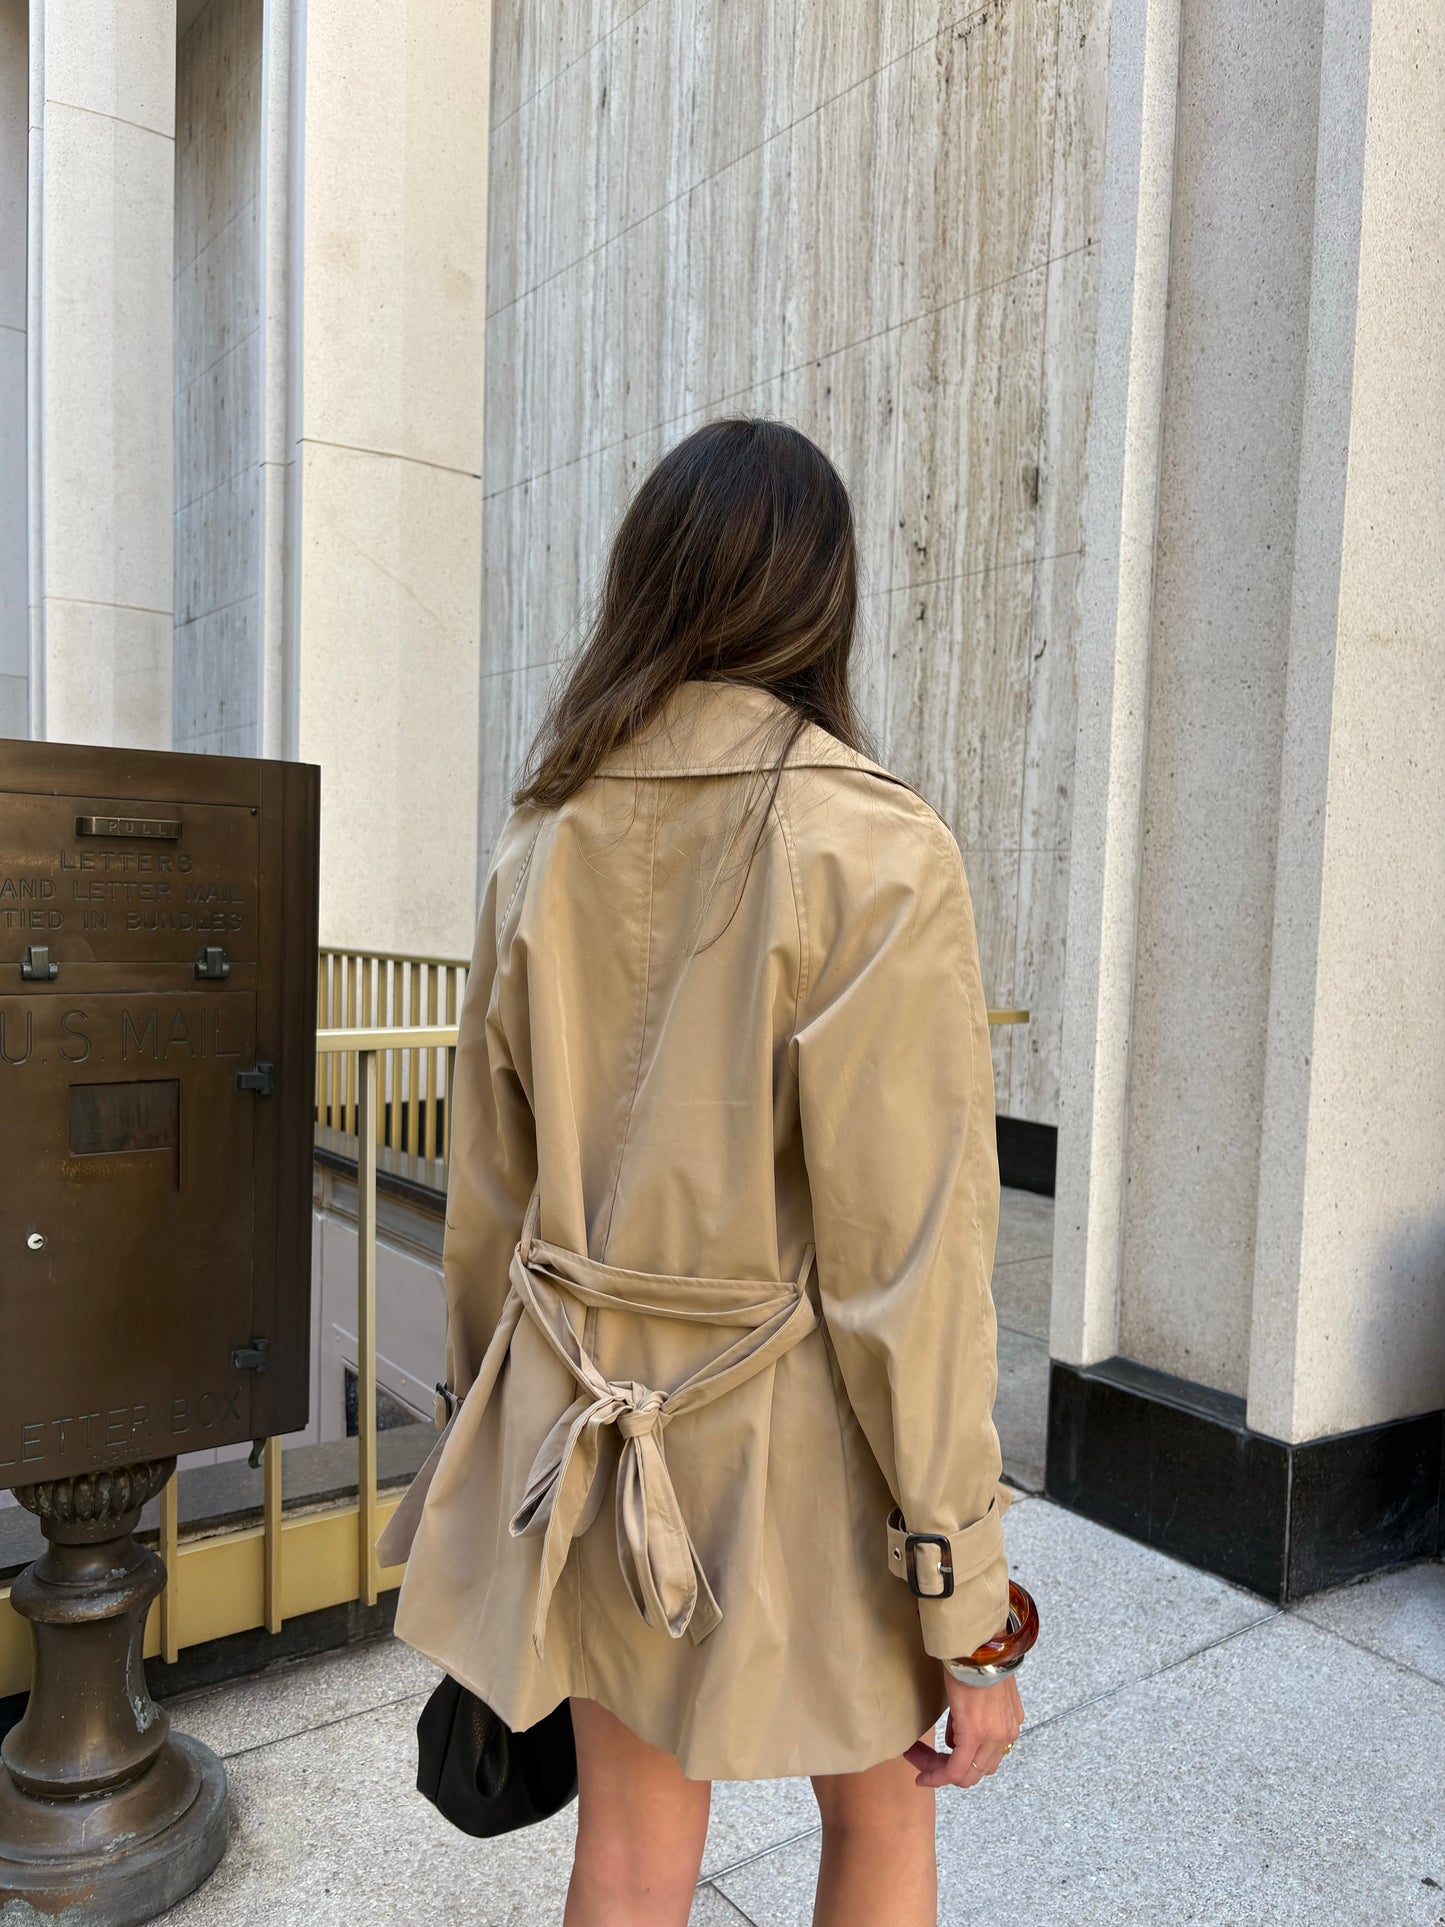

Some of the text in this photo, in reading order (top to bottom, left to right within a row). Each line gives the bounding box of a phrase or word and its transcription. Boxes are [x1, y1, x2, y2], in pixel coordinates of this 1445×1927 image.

[108, 820, 168, 835] PULL
[60, 849, 193, 875] LETTERS
[0, 878, 244, 905] AND LETTER MAIL
[1, 908, 244, 932] TIED IN BUNDLES
[121, 1007, 241, 1061] MAIL
[171, 1386, 243, 1435] BOX
